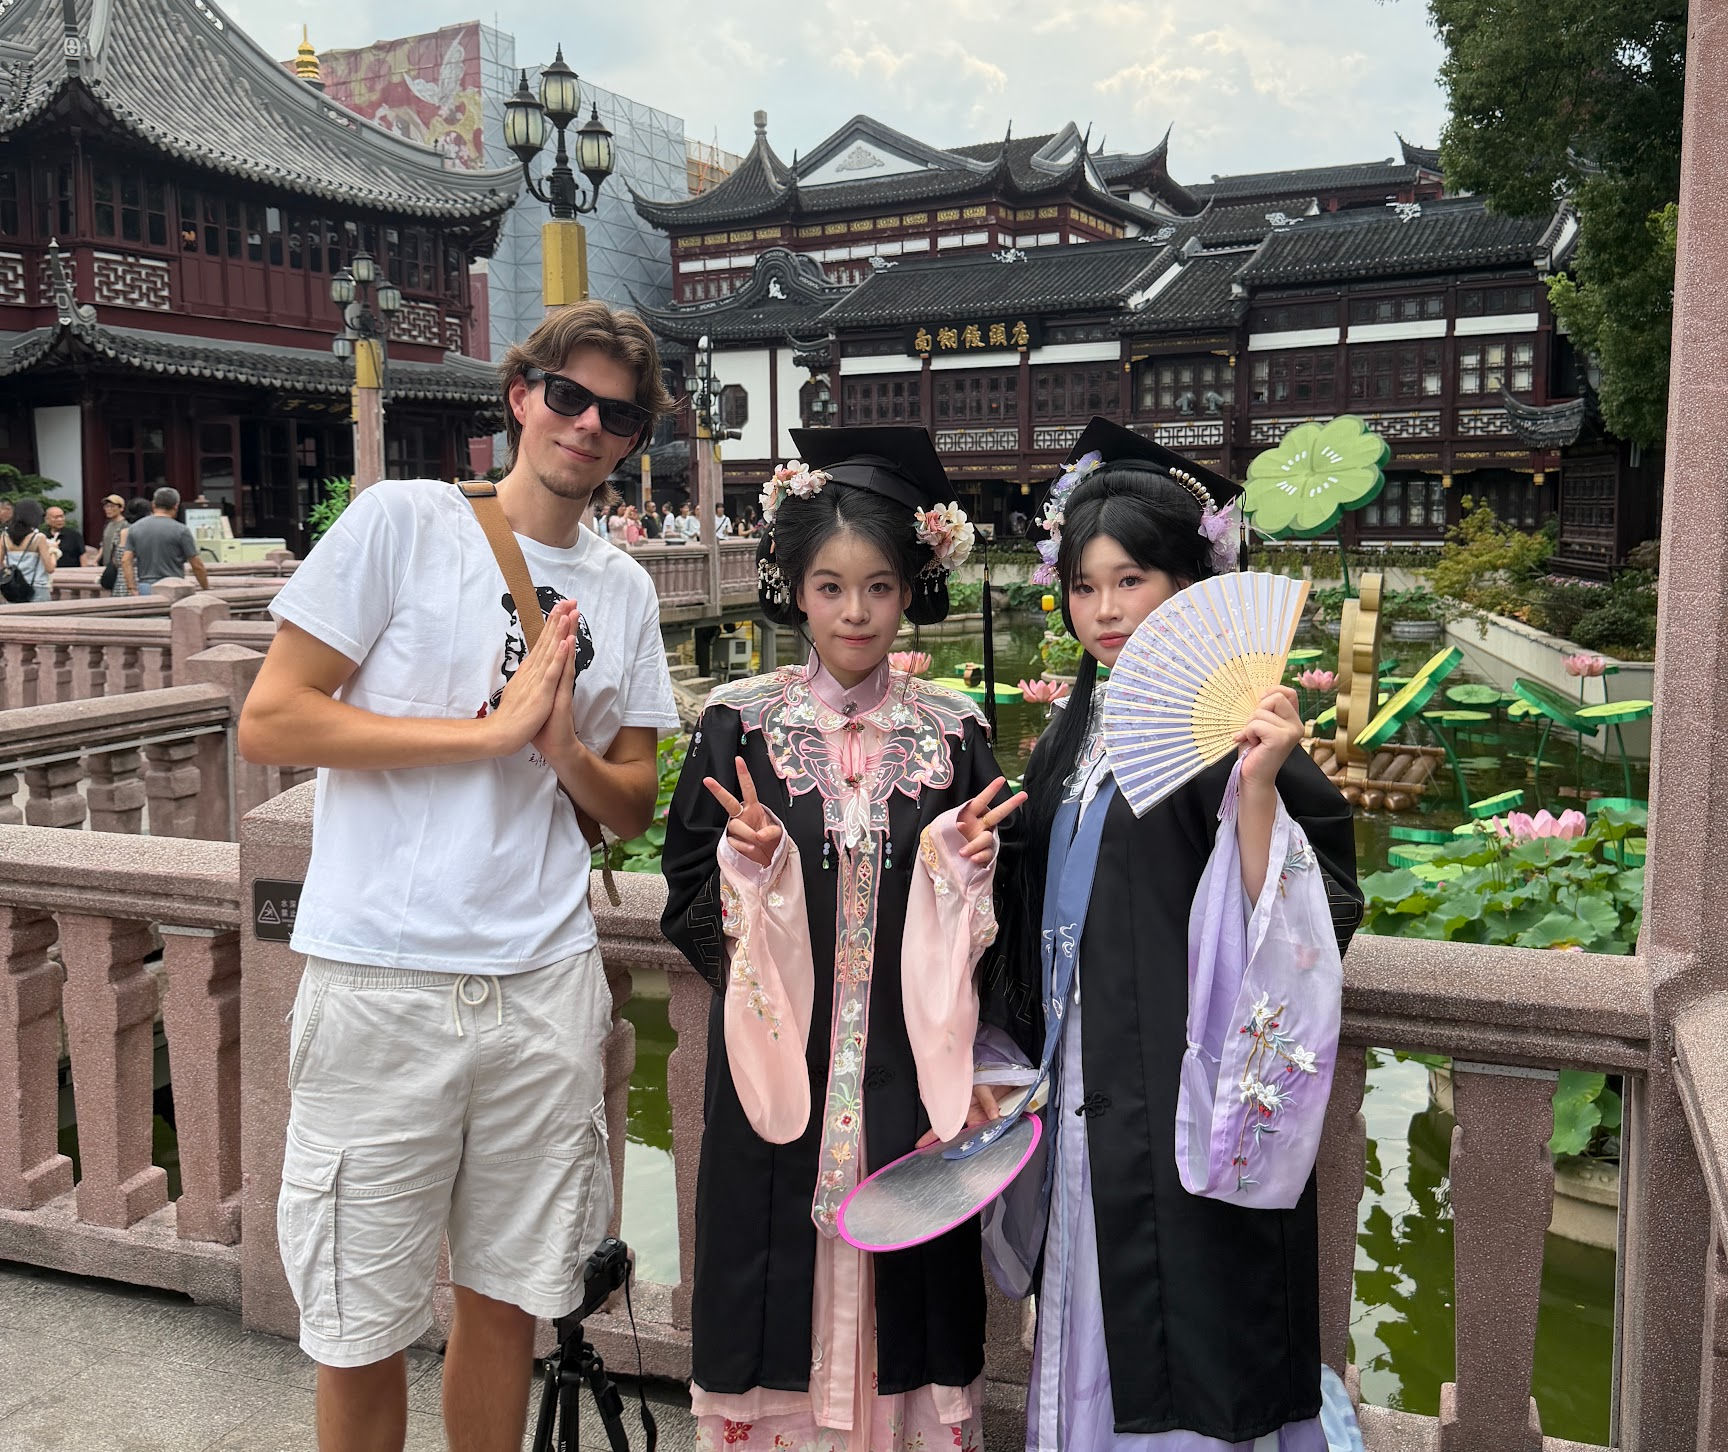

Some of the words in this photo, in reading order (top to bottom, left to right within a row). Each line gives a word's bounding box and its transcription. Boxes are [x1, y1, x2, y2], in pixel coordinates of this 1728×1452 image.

[914, 320, 1029, 351] 南翔饅頭店
